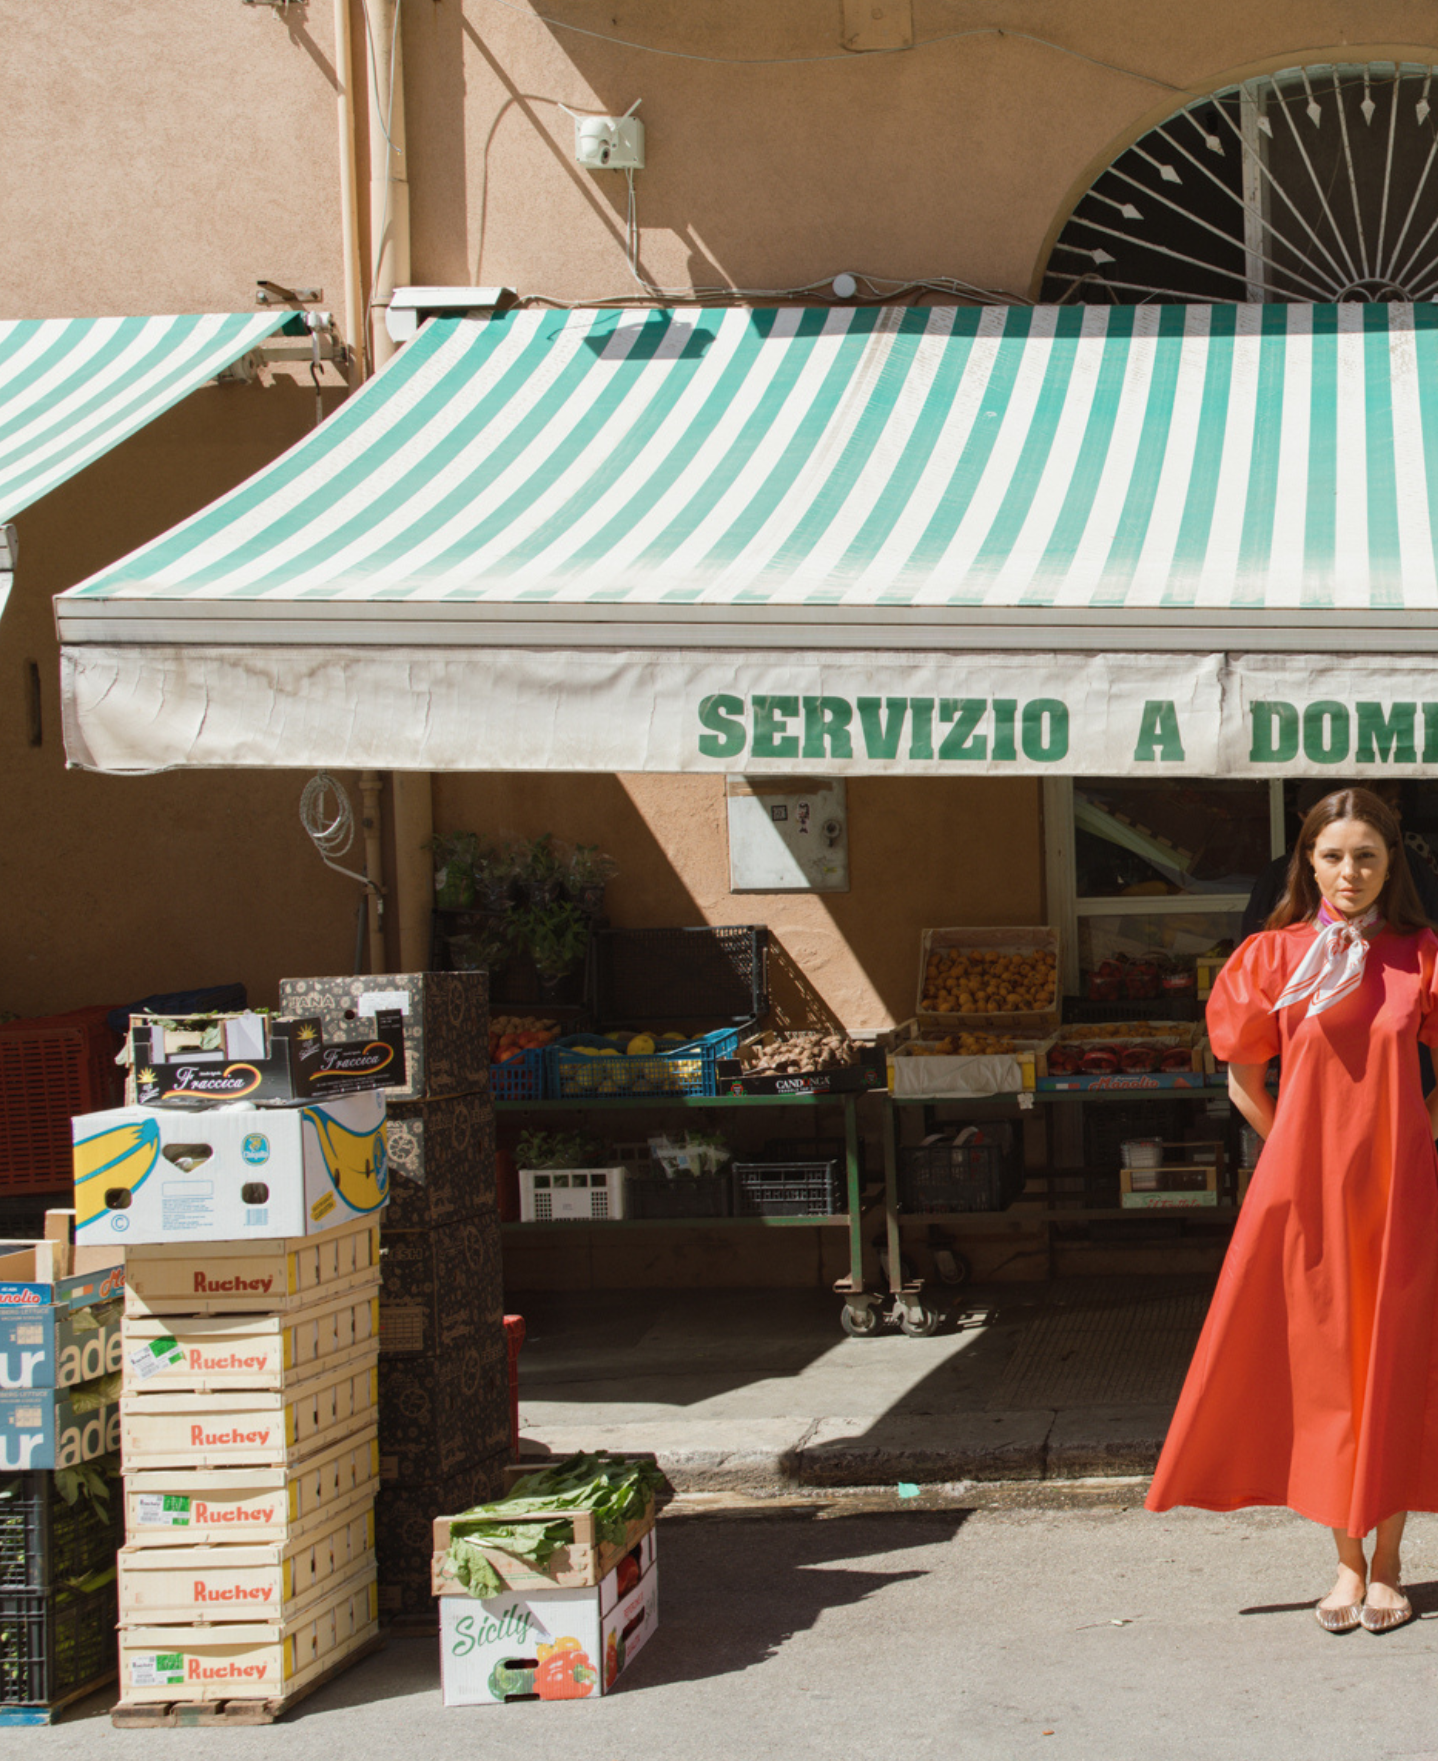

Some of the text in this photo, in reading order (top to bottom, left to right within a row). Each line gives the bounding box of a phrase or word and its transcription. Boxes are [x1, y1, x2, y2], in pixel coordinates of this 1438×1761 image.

[698, 693, 1070, 763] SERVIZIO
[1134, 699, 1186, 763] A
[776, 1076, 830, 1089] CANDONGA
[1089, 1075, 1159, 1091] Manolio
[194, 1271, 273, 1293] Ruchey
[189, 1349, 267, 1371] Ruchey
[191, 1425, 270, 1446] Ruchey
[195, 1502, 274, 1523] Ruchey
[194, 1581, 273, 1602] Ruchey
[452, 1603, 534, 1657] Sicily
[188, 1658, 267, 1680] Ruchey
